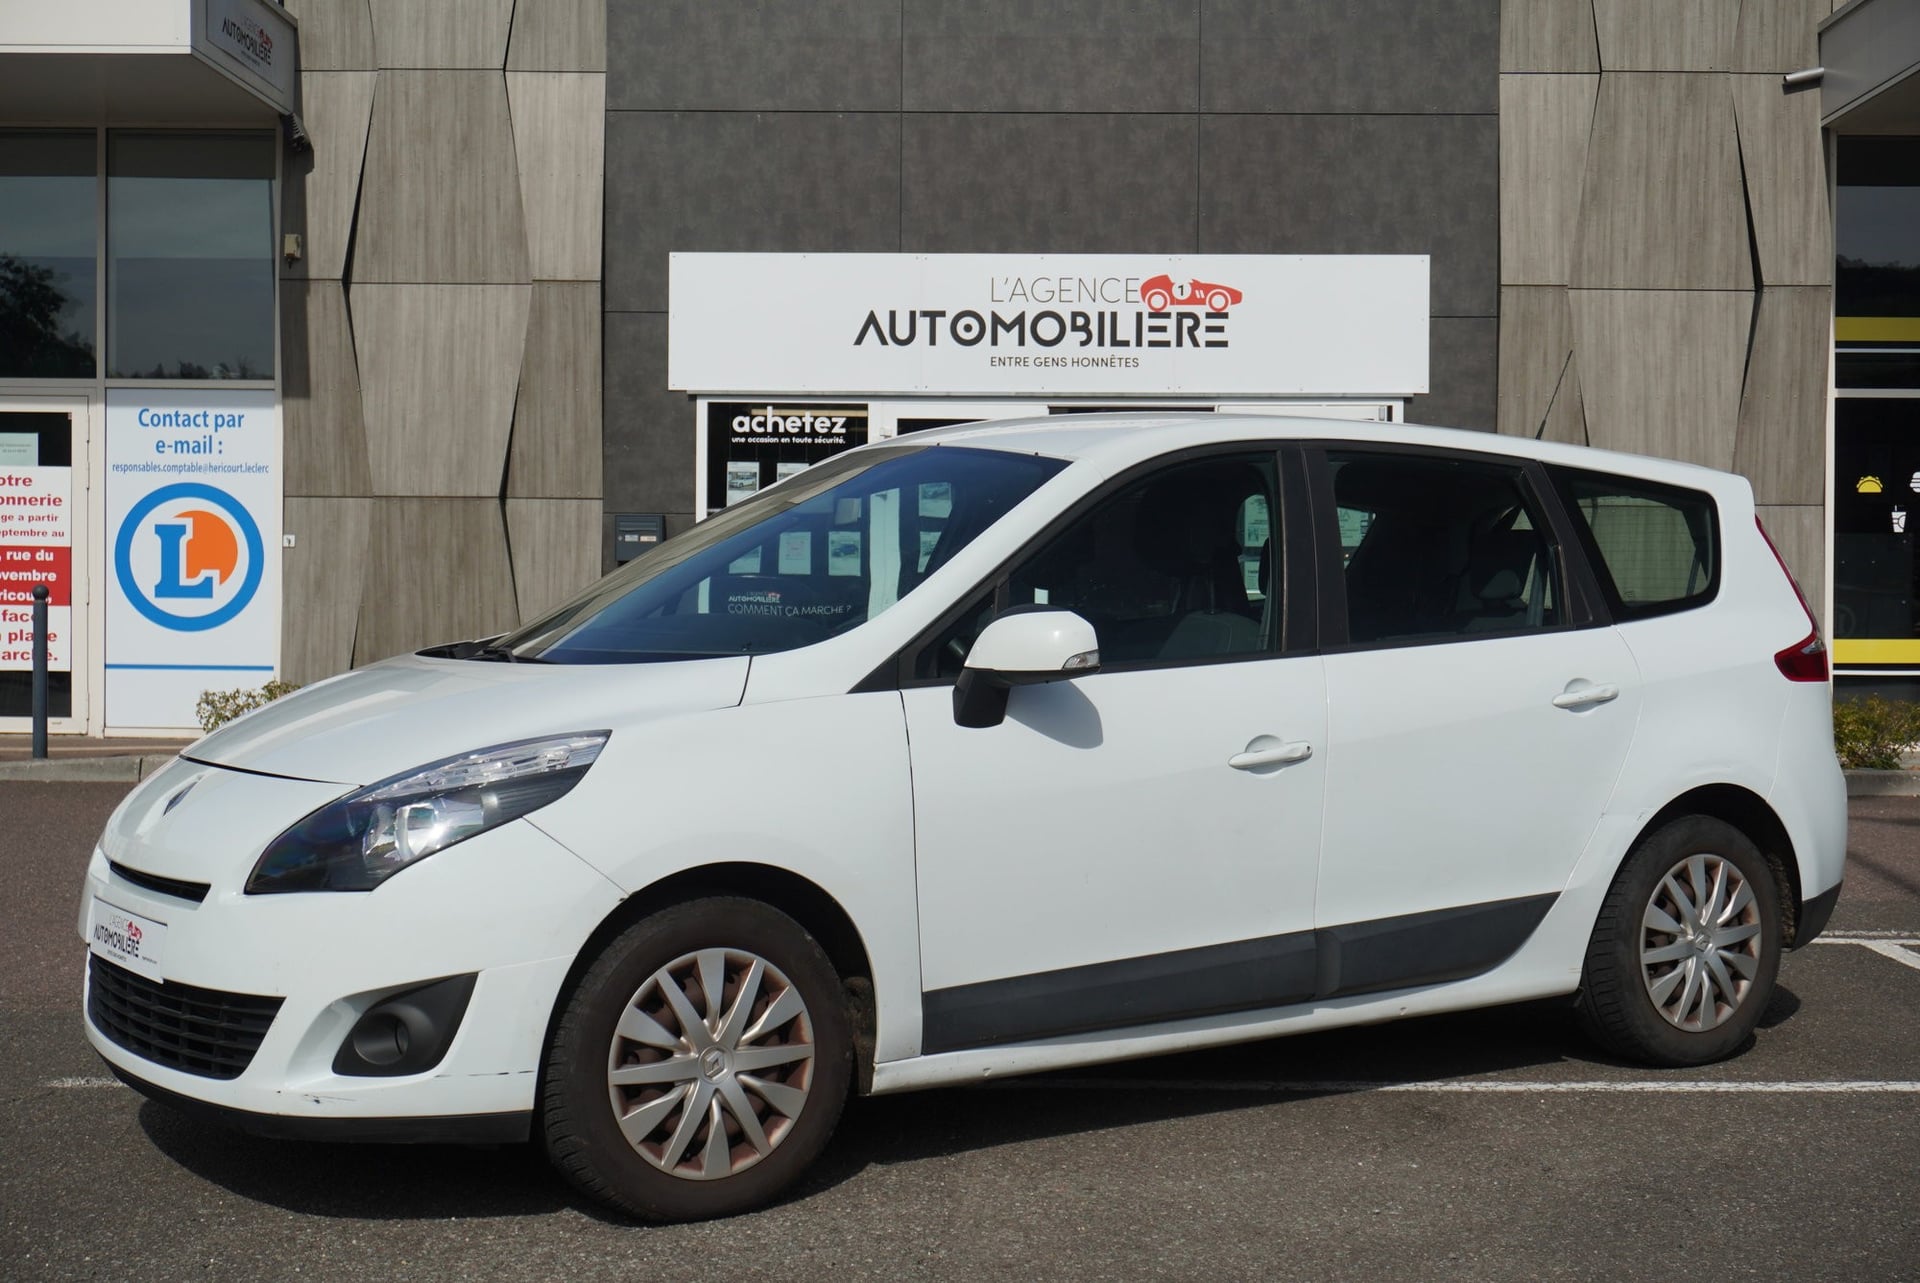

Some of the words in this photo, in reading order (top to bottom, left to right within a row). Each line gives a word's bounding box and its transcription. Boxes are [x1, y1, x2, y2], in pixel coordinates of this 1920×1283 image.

[990, 276, 1140, 304] L'AGENCE
[1177, 284, 1184, 297] 1
[853, 310, 1229, 348] AUTOMOBILIERE
[990, 357, 1030, 368] ENTRE
[1033, 357, 1068, 368] GENS
[1071, 354, 1140, 369] HONNÊTES
[138, 408, 209, 428] Contact
[214, 413, 245, 433] par
[732, 405, 847, 434] achetez
[155, 435, 212, 454] e-mail
[218, 441, 223, 454] :
[747, 435, 779, 444] occasion
[792, 436, 812, 444] toute
[814, 435, 846, 445] sécurité.
[28, 513, 59, 523] partir
[0, 528, 48, 538] ptembre
[51, 530, 65, 538] au
[6, 551, 31, 561] rue
[35, 549, 54, 561] du
[0, 569, 57, 582] vembre
[728, 603, 783, 616] COMMENT
[801, 605, 844, 615] MARCHE
[846, 604, 852, 613] ?
[8, 629, 57, 644] plae
